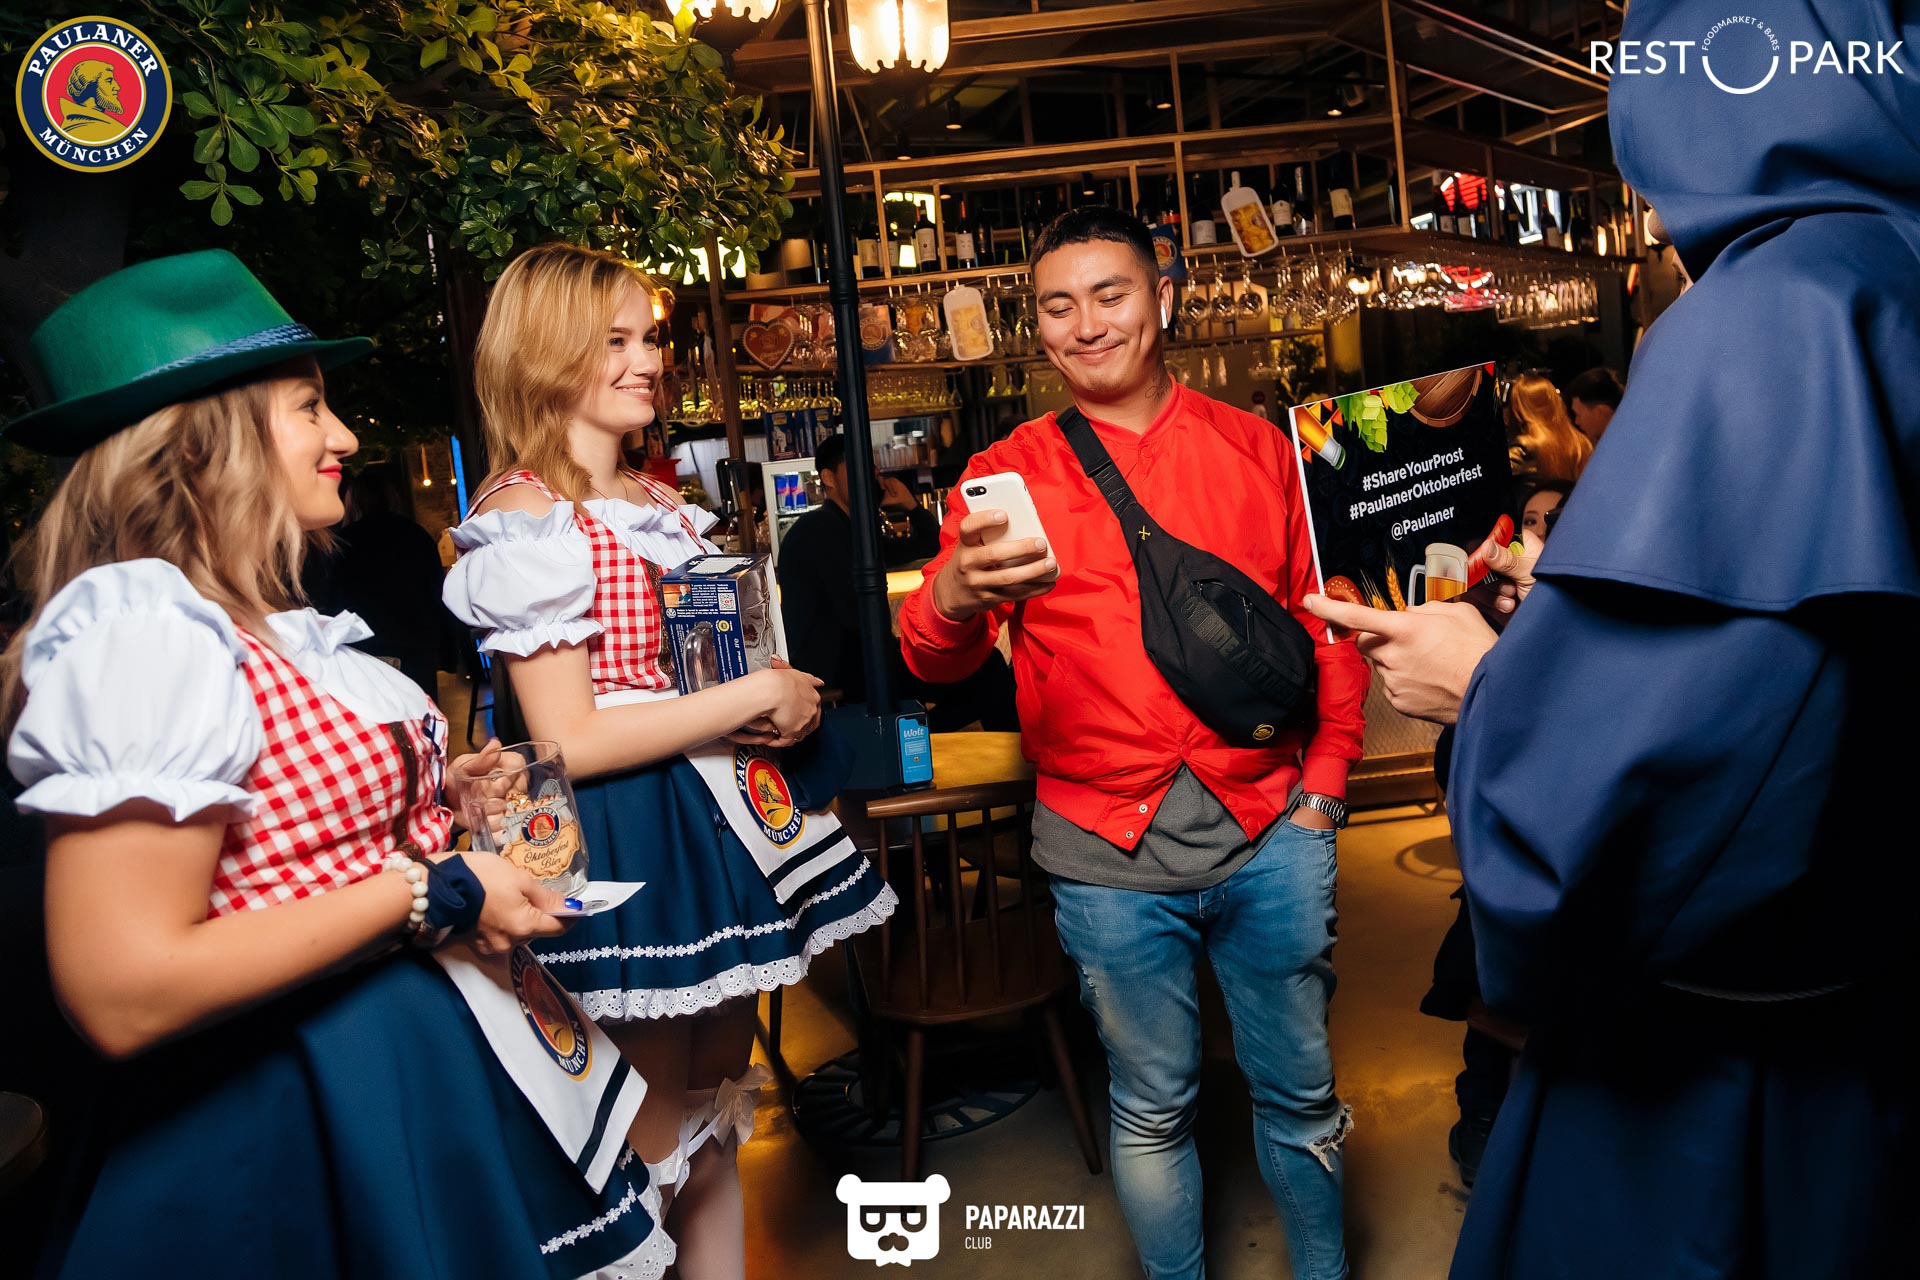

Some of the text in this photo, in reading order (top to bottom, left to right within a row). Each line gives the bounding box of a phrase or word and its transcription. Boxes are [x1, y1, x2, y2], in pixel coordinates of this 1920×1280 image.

[1362, 447, 1464, 492] #ShareYourProst
[1349, 463, 1483, 520] #PaulanerOktoberfest
[1391, 505, 1455, 541] @Paulaner
[903, 727, 925, 738] Wolt
[524, 841, 569, 864] Oktoberfest
[557, 1020, 587, 1073] MÜNCHEN
